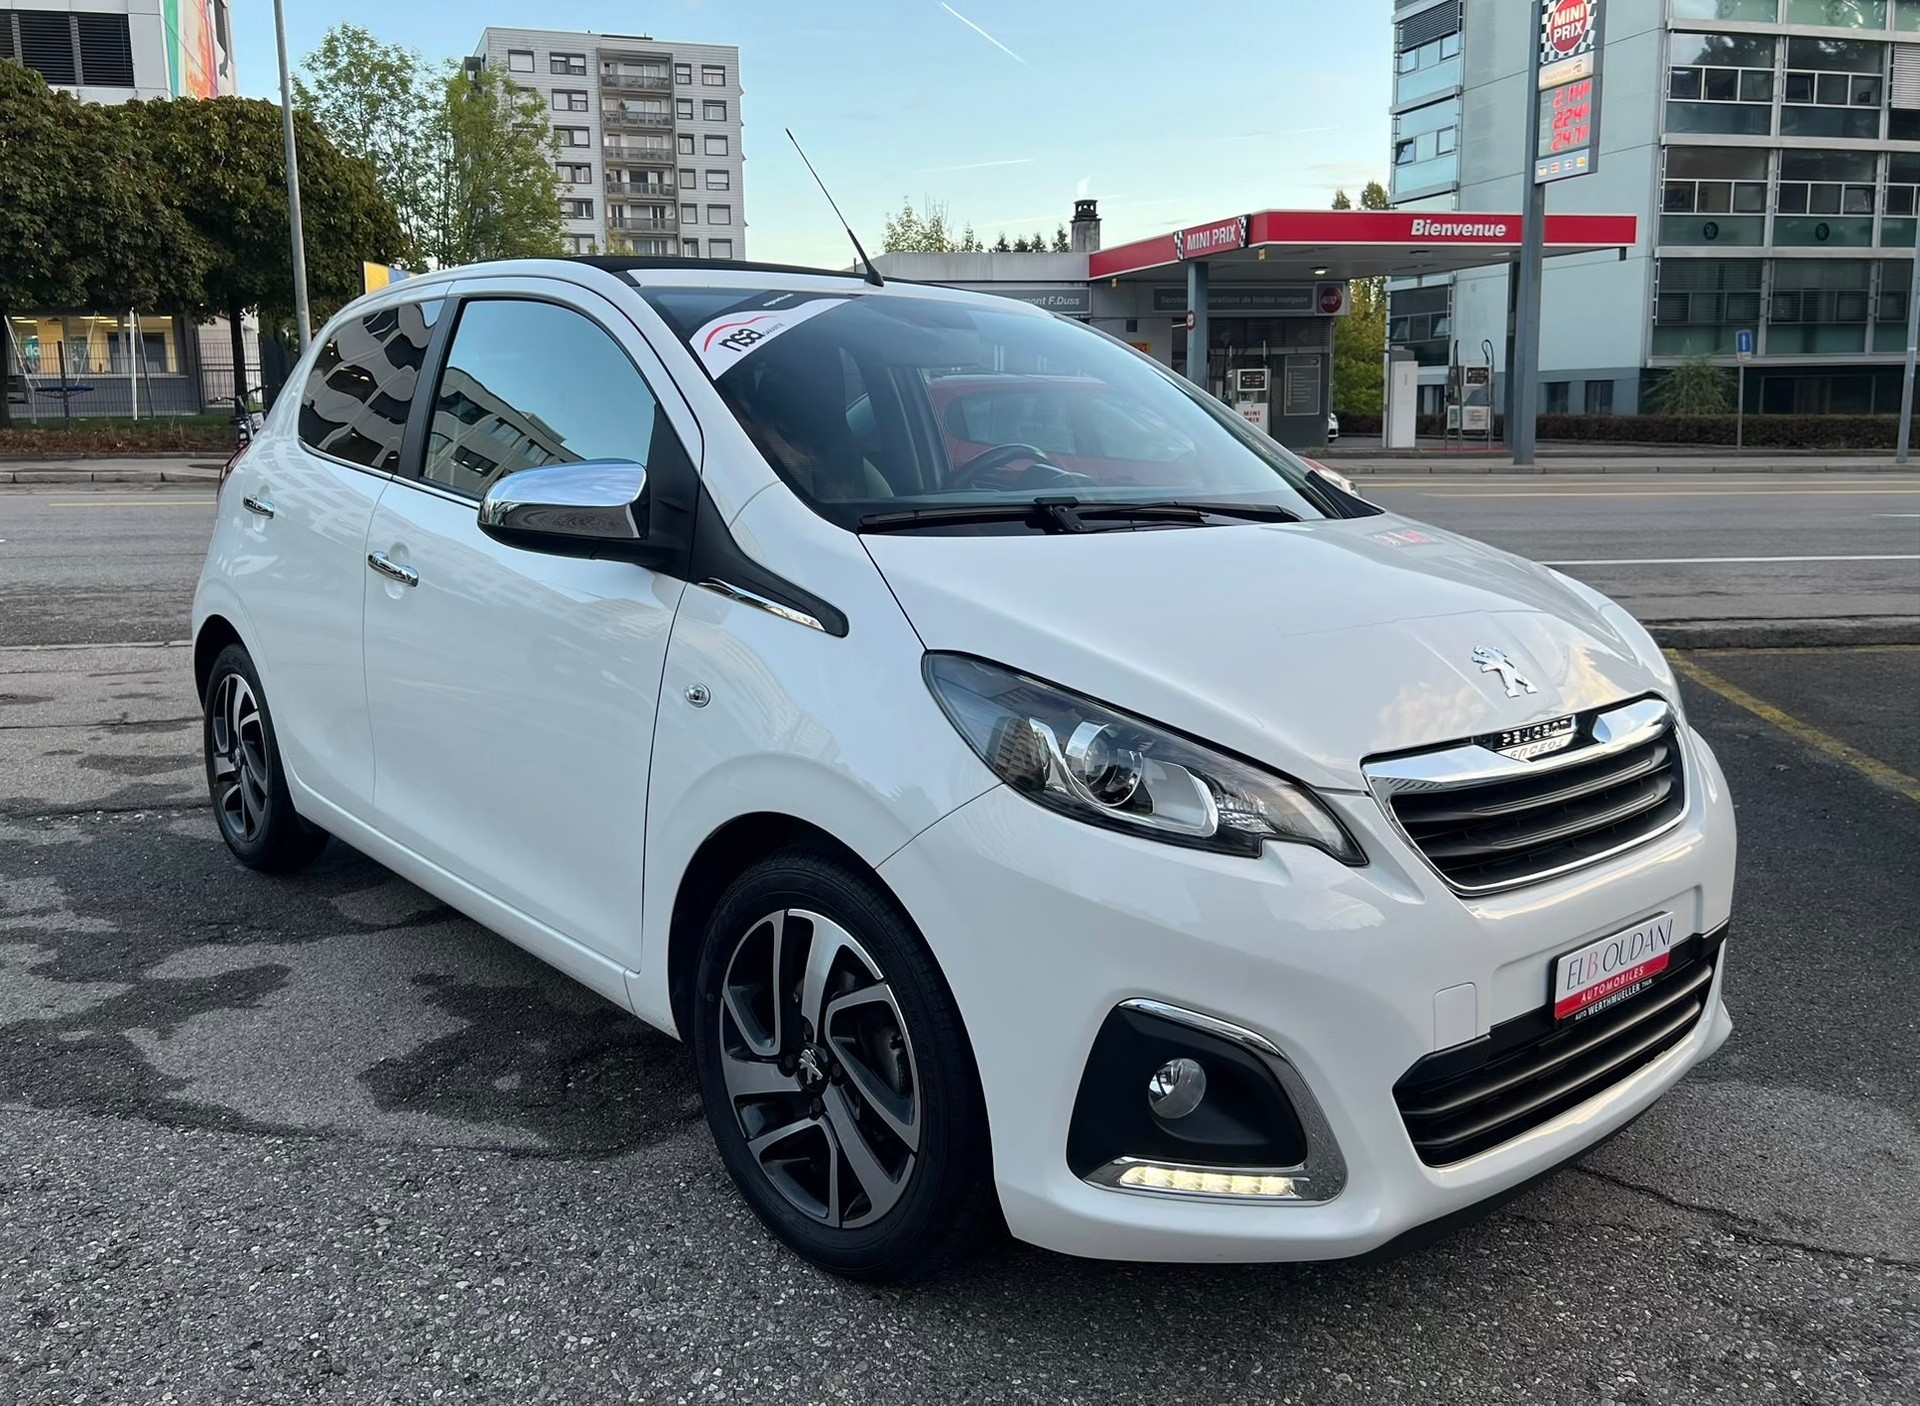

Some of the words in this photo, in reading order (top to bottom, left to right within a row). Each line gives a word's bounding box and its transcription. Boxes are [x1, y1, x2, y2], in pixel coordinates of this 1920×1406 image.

[1554, 6, 1586, 28] MINI
[1553, 22, 1583, 43] PRIX
[1187, 231, 1210, 251] MINI
[1212, 224, 1237, 246] PRIX
[1411, 219, 1507, 237] Bienvenue
[718, 328, 766, 352] nsa
[1502, 720, 1570, 746] PEUGEOT
[1581, 966, 1645, 1003] AUTOMOBILES
[1587, 983, 1641, 1016] WERTHMUELLER
